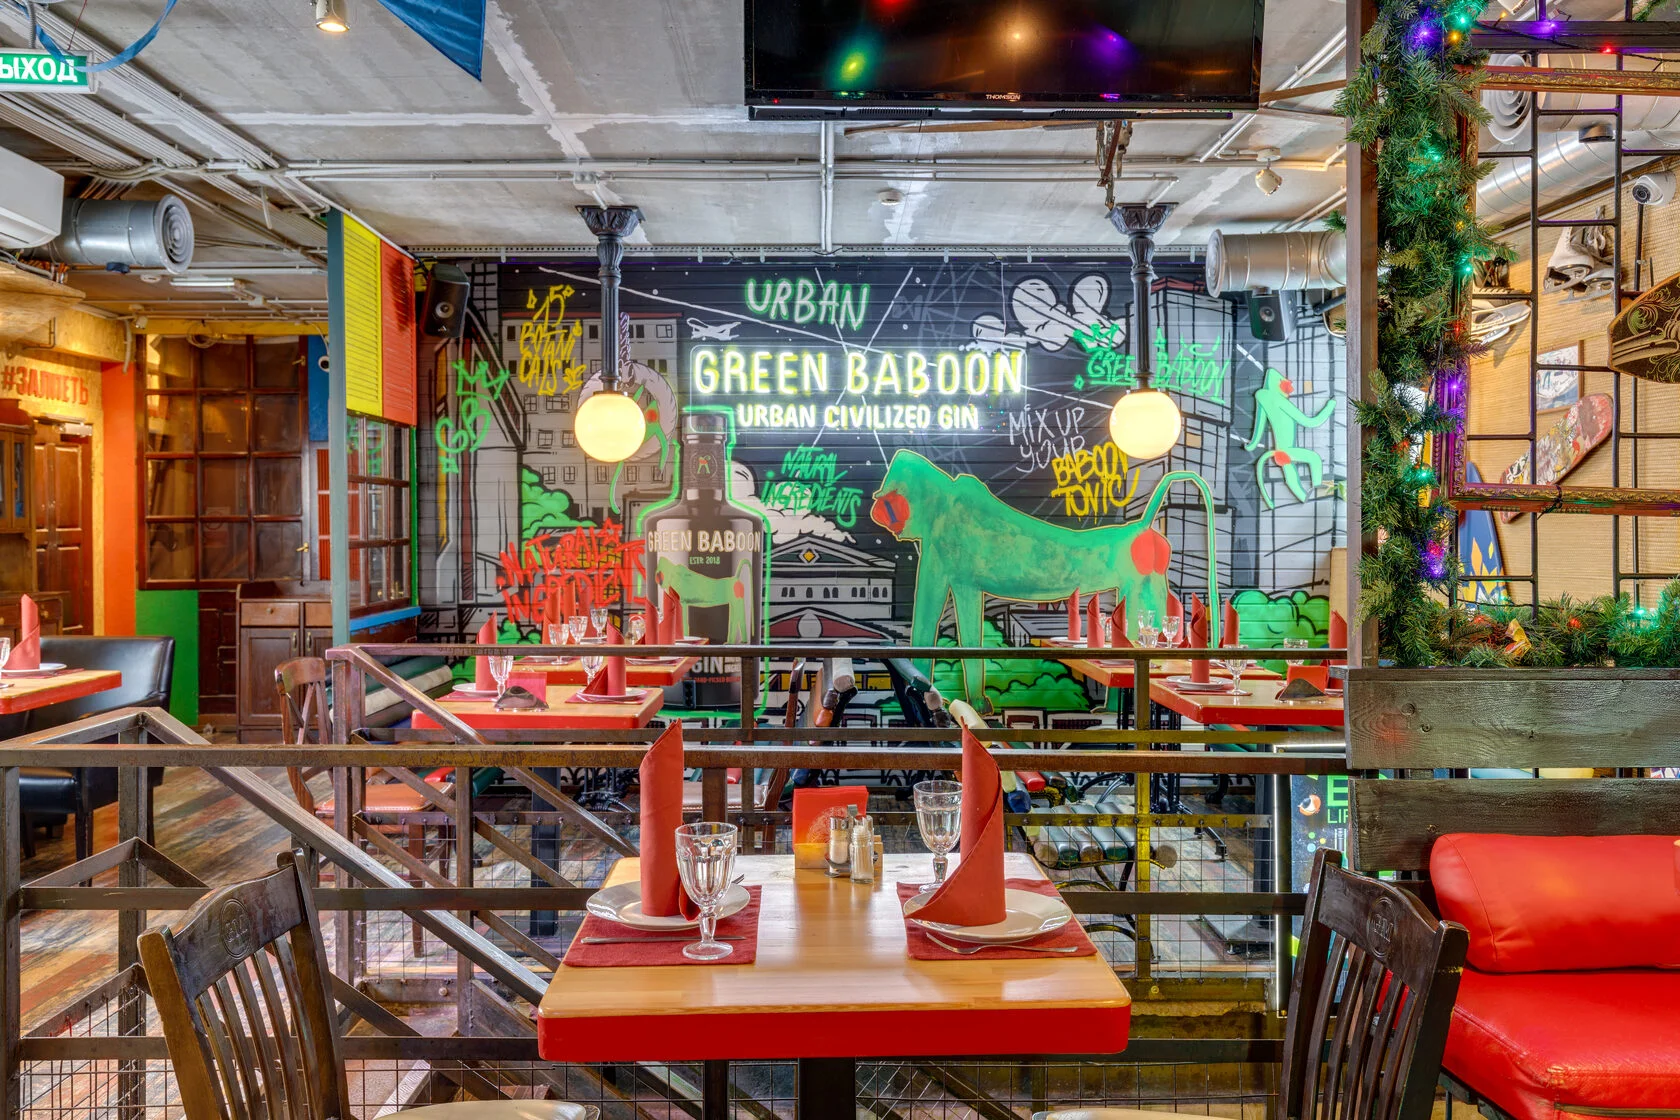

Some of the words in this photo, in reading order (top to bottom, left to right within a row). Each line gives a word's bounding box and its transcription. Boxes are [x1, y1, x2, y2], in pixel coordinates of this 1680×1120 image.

[745, 278, 870, 331] URBAN
[694, 350, 828, 396] GREEN
[846, 350, 1024, 396] BABOON
[1086, 351, 1138, 384] GREE
[1155, 351, 1230, 404] BABOON
[738, 404, 817, 429] URBAN
[824, 404, 931, 429] CIVILIZED
[938, 404, 980, 430] GIN
[1055, 407, 1085, 436] UP
[781, 443, 848, 486] NATURAL
[760, 470, 864, 528] INGREDIENTS
[1051, 473, 1140, 518] TONIC
[500, 525, 610, 587] NATURAL
[648, 530, 692, 552] GREEN
[697, 530, 761, 553] BABOON
